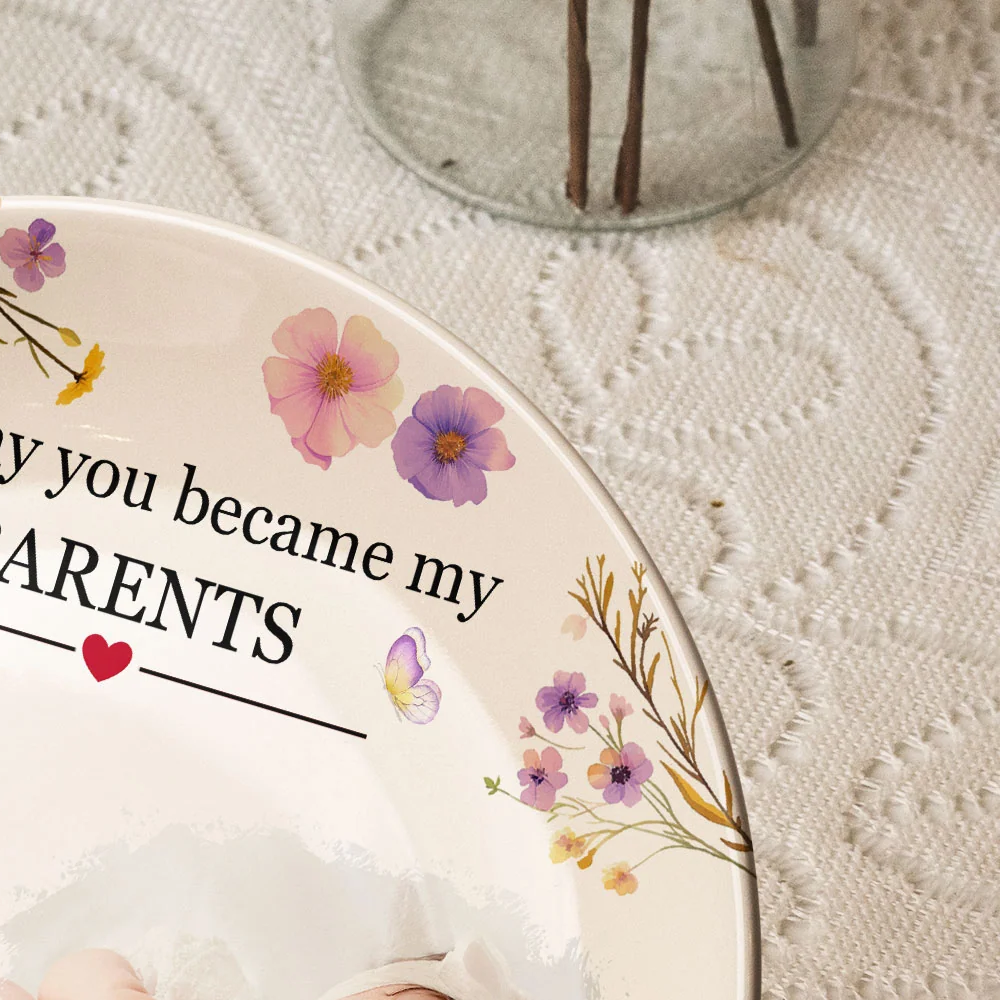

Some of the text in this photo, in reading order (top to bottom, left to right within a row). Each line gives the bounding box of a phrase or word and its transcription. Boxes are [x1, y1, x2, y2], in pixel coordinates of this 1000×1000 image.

[44, 446, 158, 513] you
[172, 462, 394, 581] became
[404, 552, 505, 623] my
